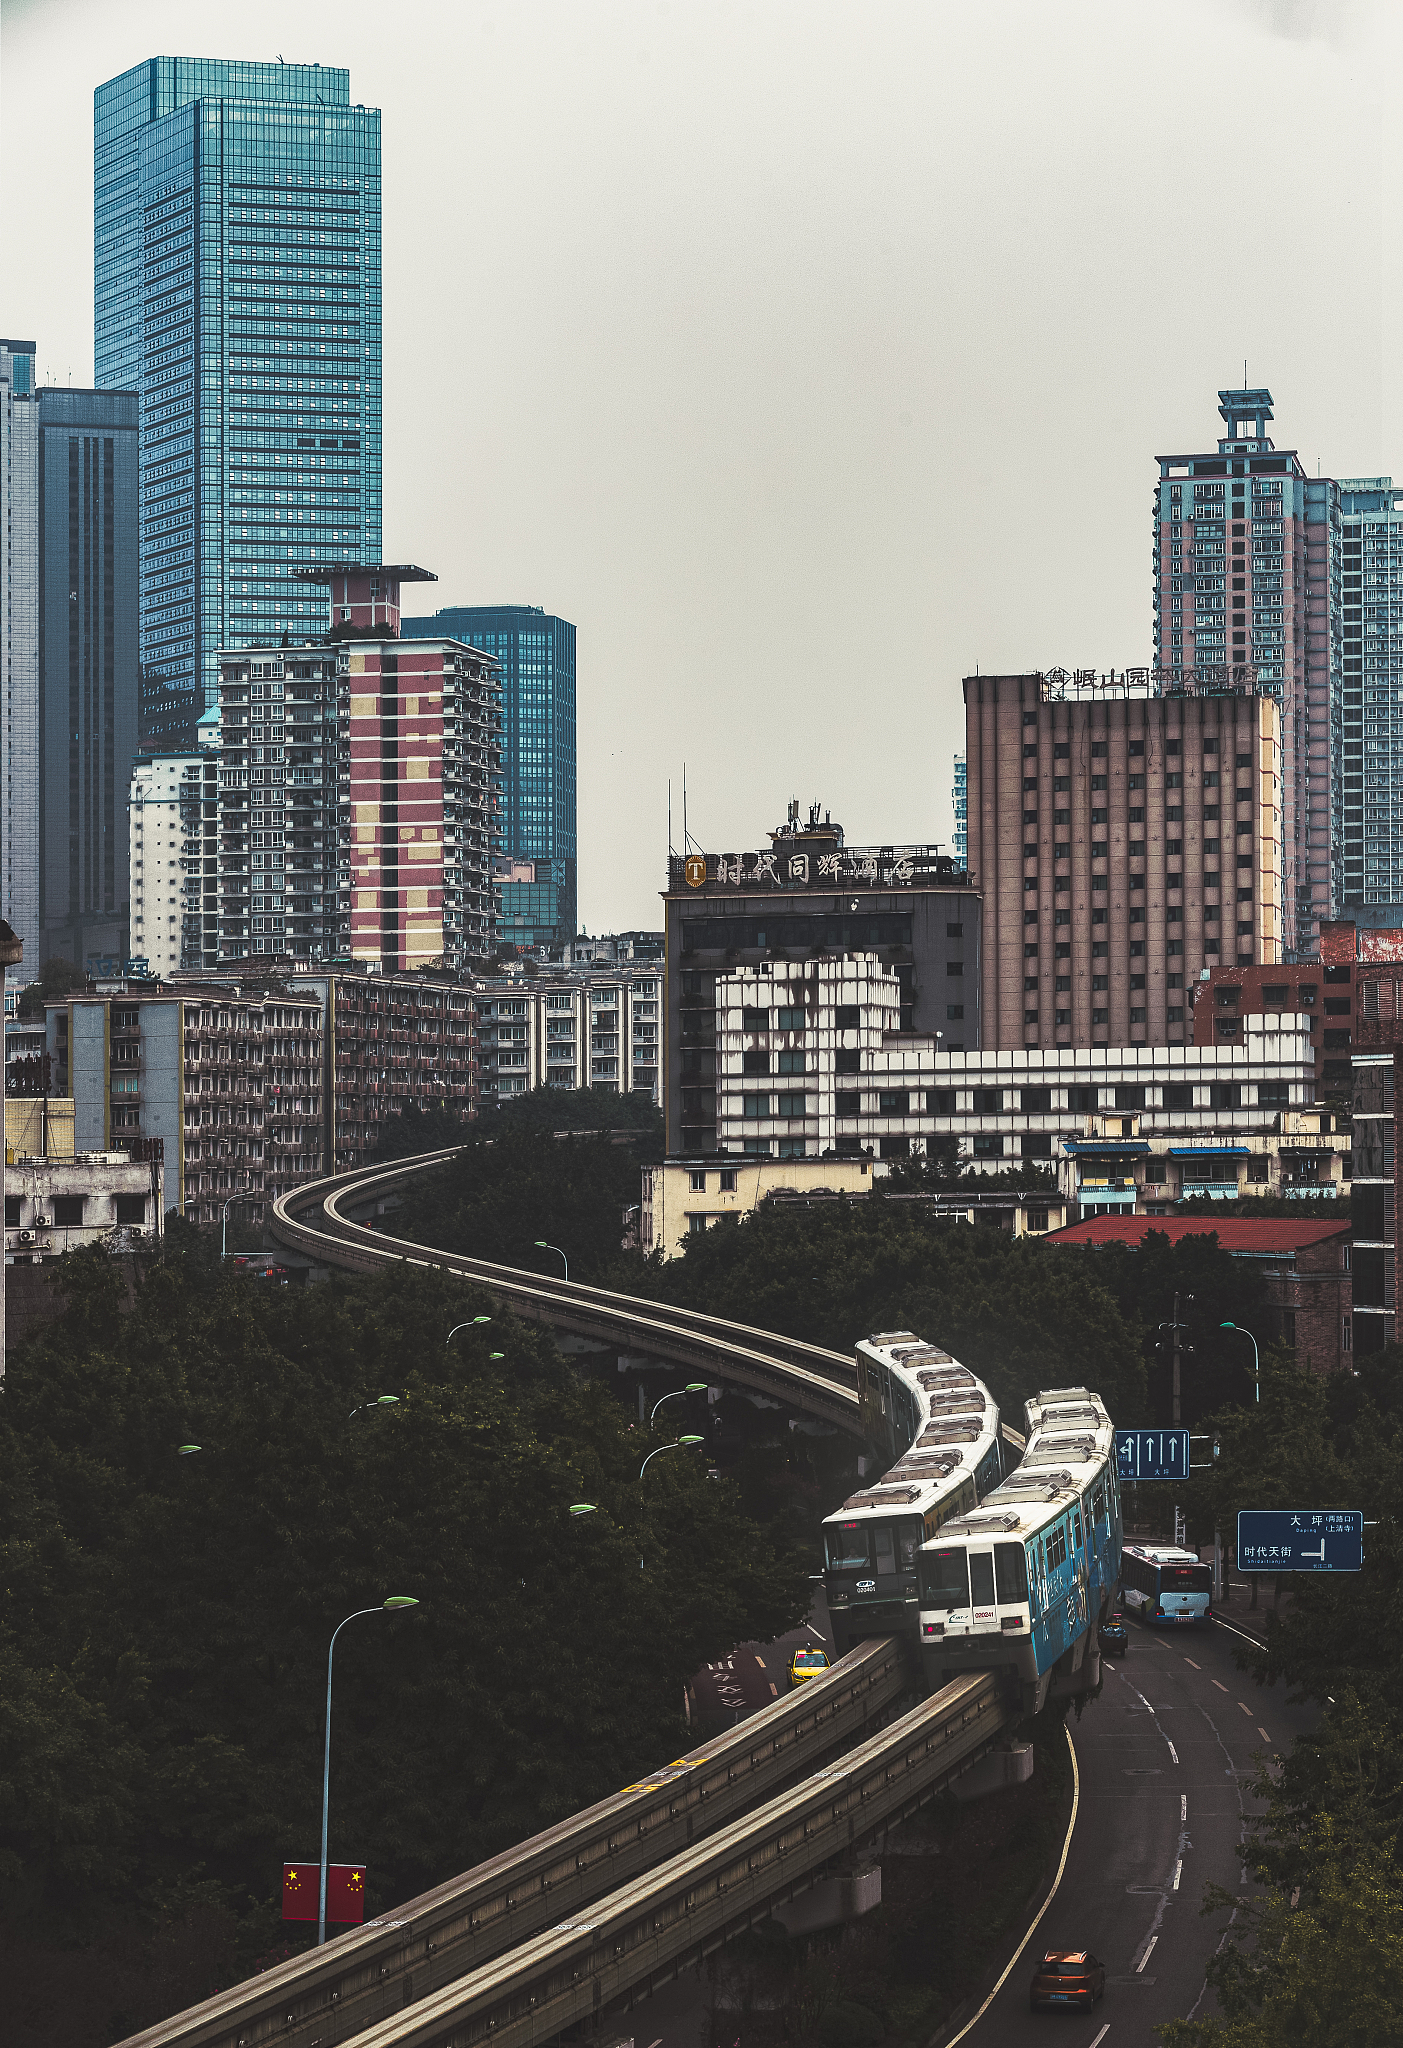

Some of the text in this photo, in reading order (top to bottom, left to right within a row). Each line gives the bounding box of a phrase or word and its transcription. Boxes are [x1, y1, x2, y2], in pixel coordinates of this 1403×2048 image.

[717, 852, 916, 885] 时代同辉酒店
[1244, 1546, 1292, 1557] 时代天街
[975, 1611, 994, 1619] 020241
